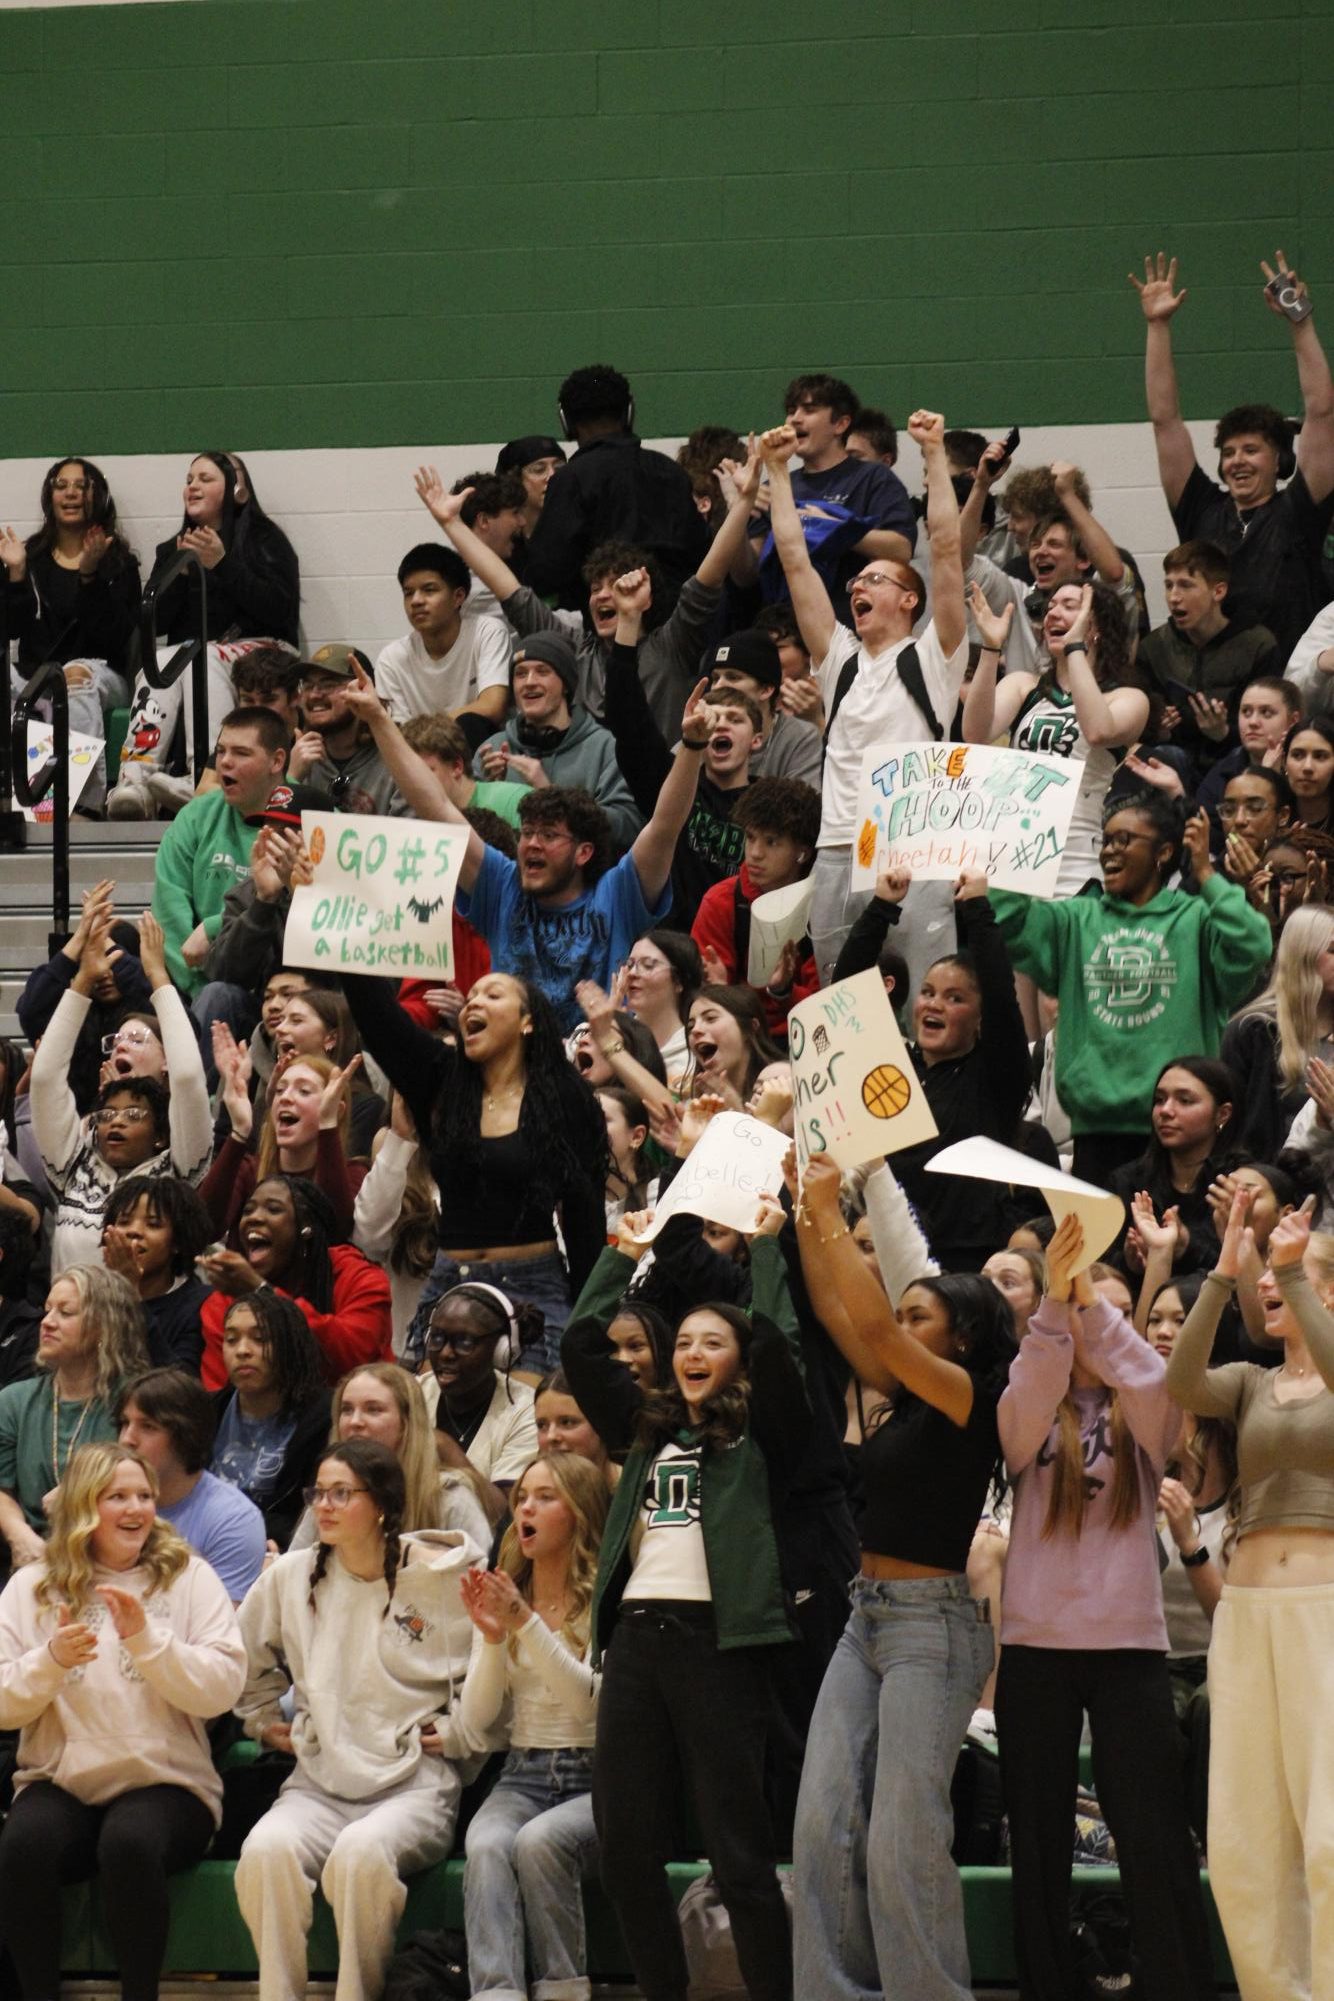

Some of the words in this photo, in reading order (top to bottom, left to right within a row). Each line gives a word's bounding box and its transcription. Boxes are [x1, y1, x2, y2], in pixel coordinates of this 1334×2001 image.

[871, 746, 970, 797] TAKE
[981, 753, 1070, 803] IT
[336, 828, 388, 881] GO
[1009, 825, 1065, 872] #21
[369, 903, 405, 936] get
[314, 937, 332, 958] a
[340, 937, 450, 970] basketball
[1129, 965, 1177, 980] FOOTBALL
[820, 985, 857, 1028] DHS
[732, 1118, 763, 1148] Go
